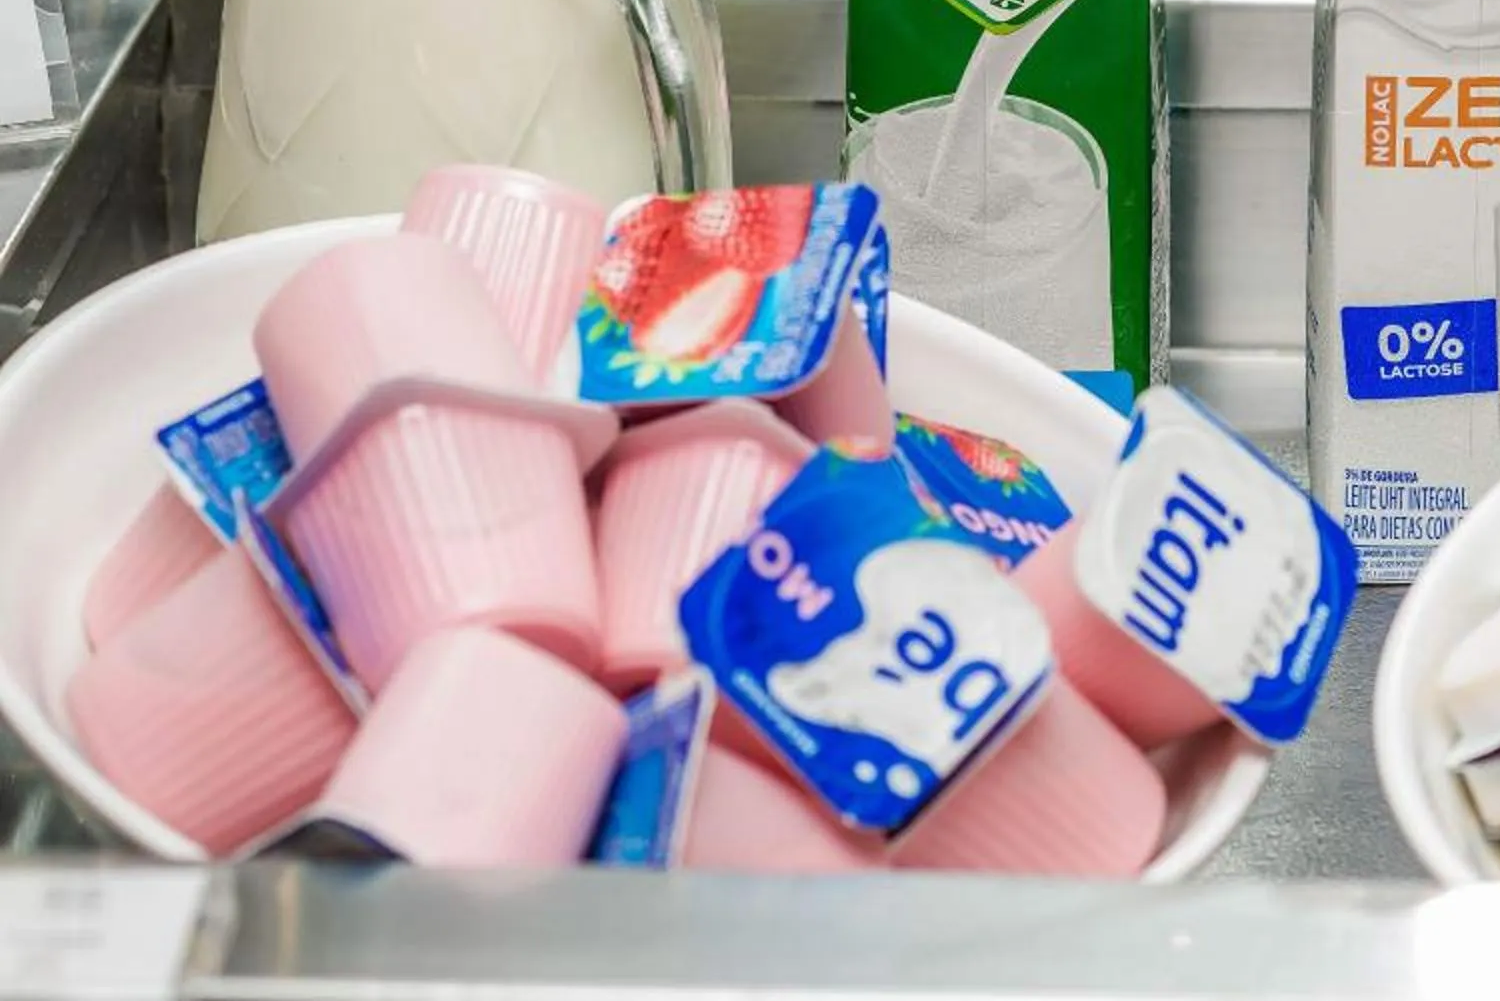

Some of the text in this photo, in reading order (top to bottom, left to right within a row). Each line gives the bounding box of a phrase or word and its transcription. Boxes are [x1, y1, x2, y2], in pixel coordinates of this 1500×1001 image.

[1371, 80, 1393, 161] NOLAC
[1377, 320, 1465, 363] 0%
[1379, 362, 1464, 380] LACTOSE
[1345, 484, 1470, 512] LEITE UHT INTEGRAL
[1344, 514, 1377, 539] PARA
[1380, 516, 1423, 540] DIETAS
